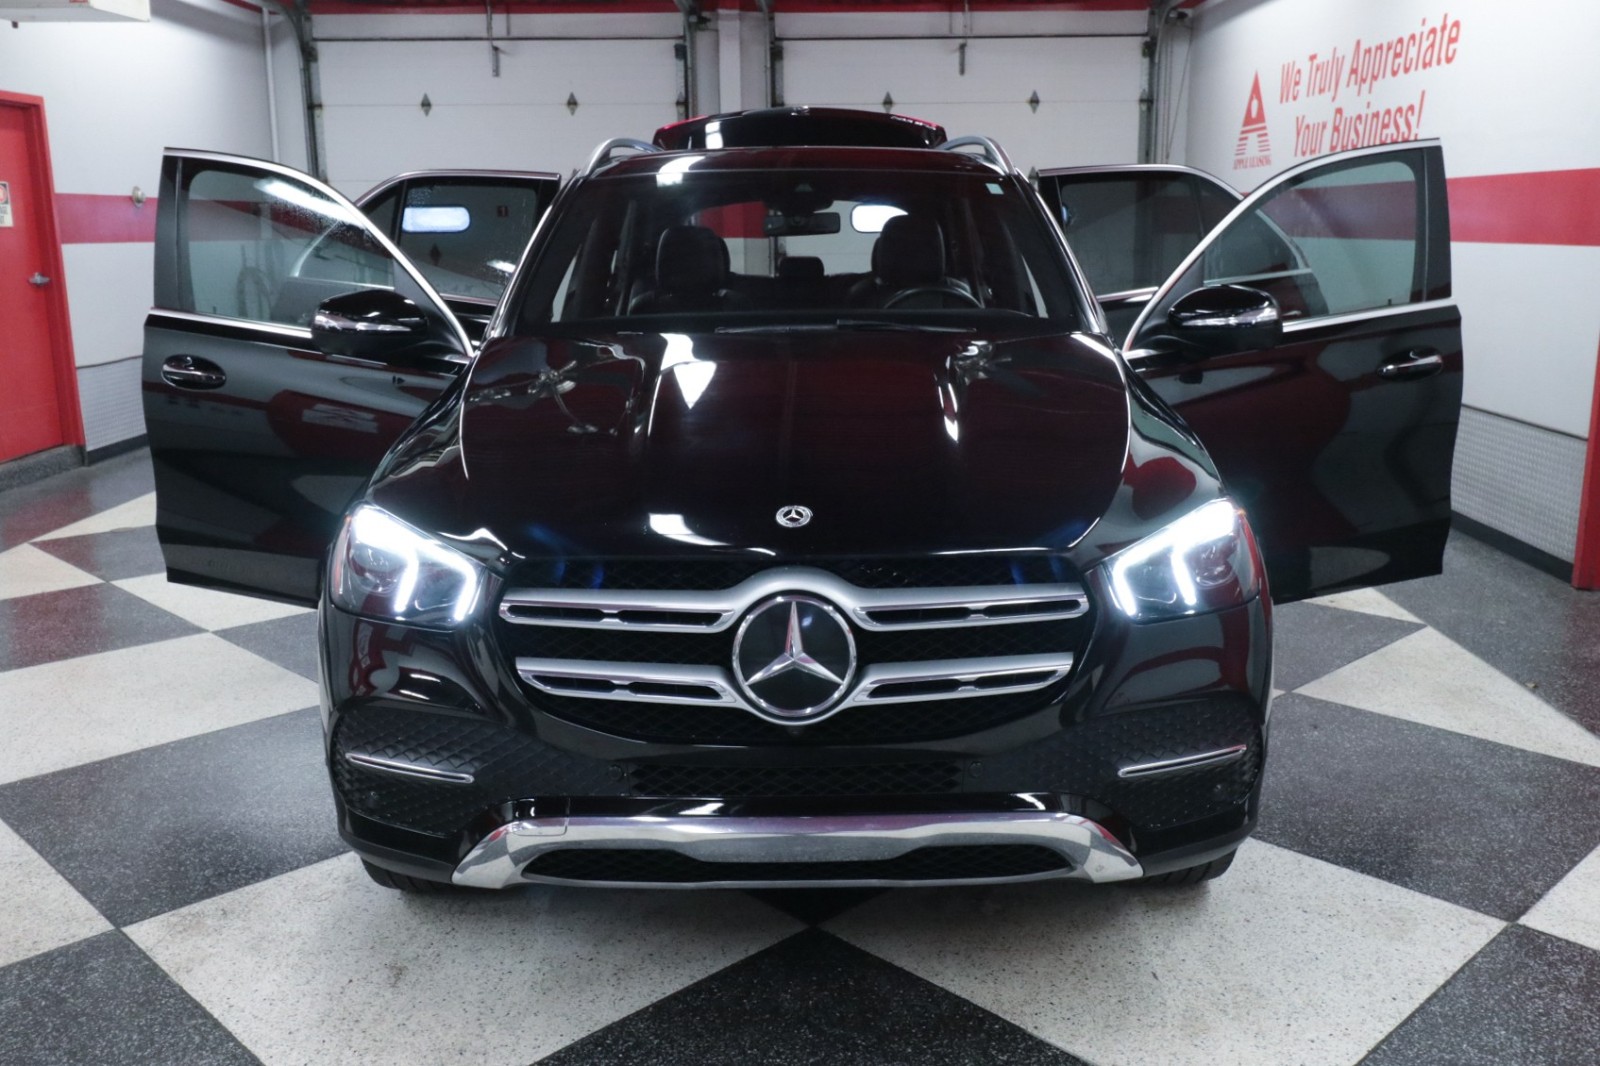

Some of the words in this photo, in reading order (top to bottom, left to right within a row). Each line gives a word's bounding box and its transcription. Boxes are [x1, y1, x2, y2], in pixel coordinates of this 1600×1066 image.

[1279, 61, 1302, 104] We
[1306, 47, 1345, 102] Truly
[1346, 13, 1462, 97] Appreciate
[1294, 114, 1327, 157] Your
[1329, 90, 1426, 152] Business!
